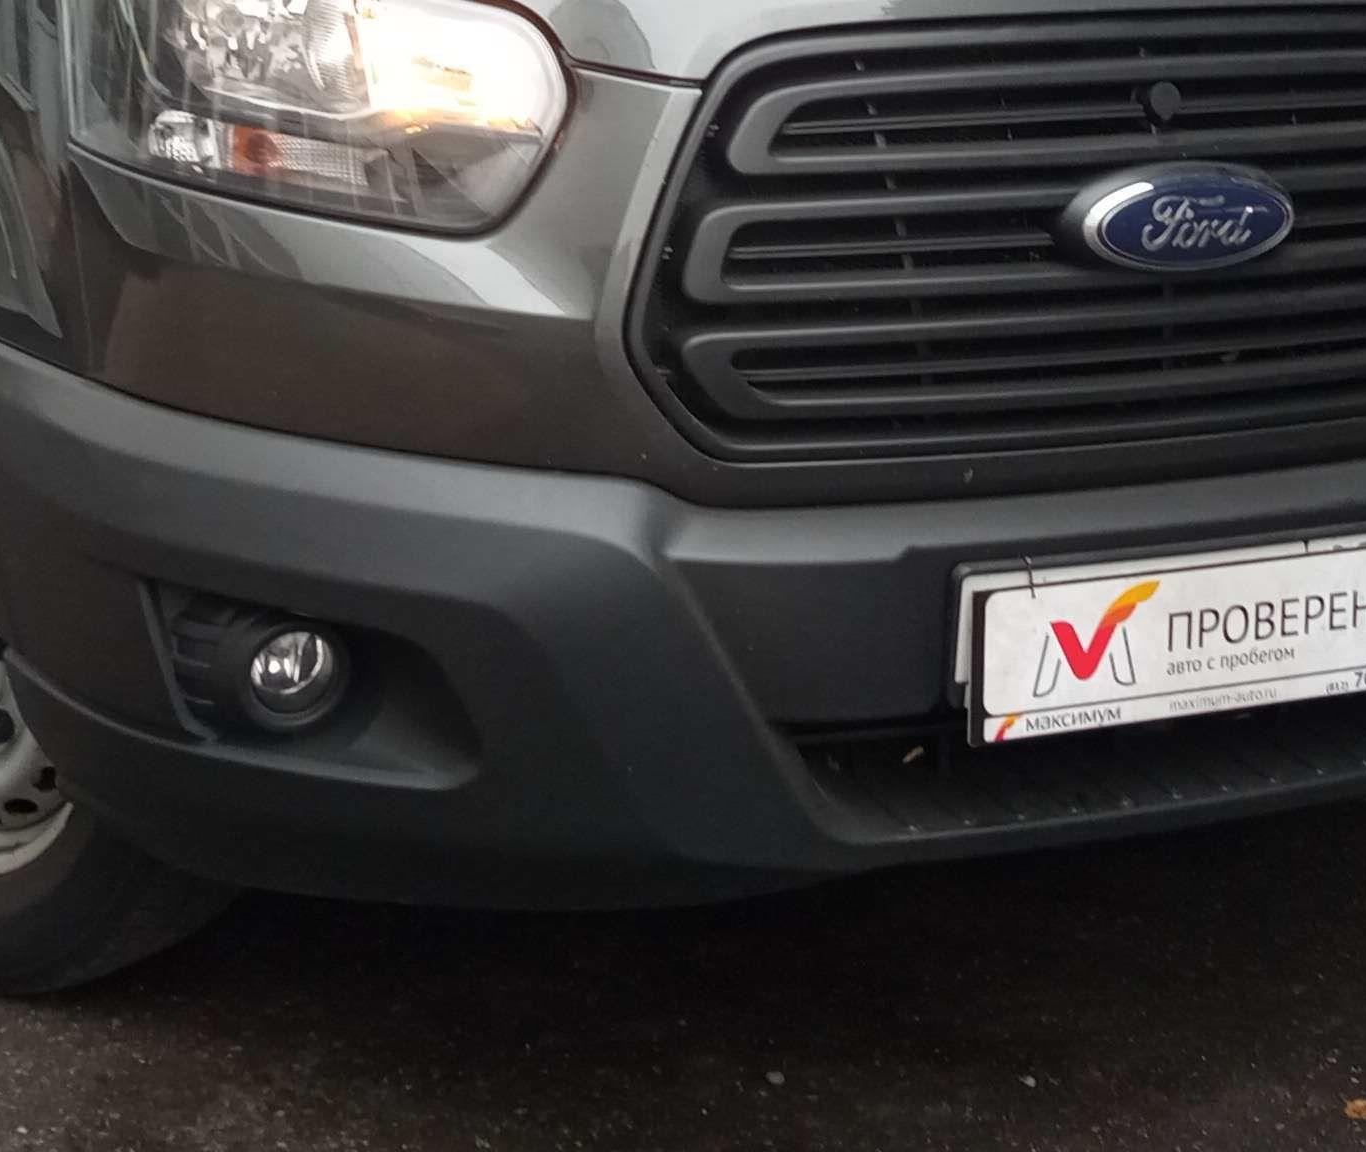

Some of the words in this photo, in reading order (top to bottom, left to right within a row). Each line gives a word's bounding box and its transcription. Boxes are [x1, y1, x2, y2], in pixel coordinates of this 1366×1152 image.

[1141, 194, 1252, 251] Ford
[1166, 658, 1202, 676] авто
[1207, 656, 1216, 670] с
[1220, 647, 1295, 672] пробегом
